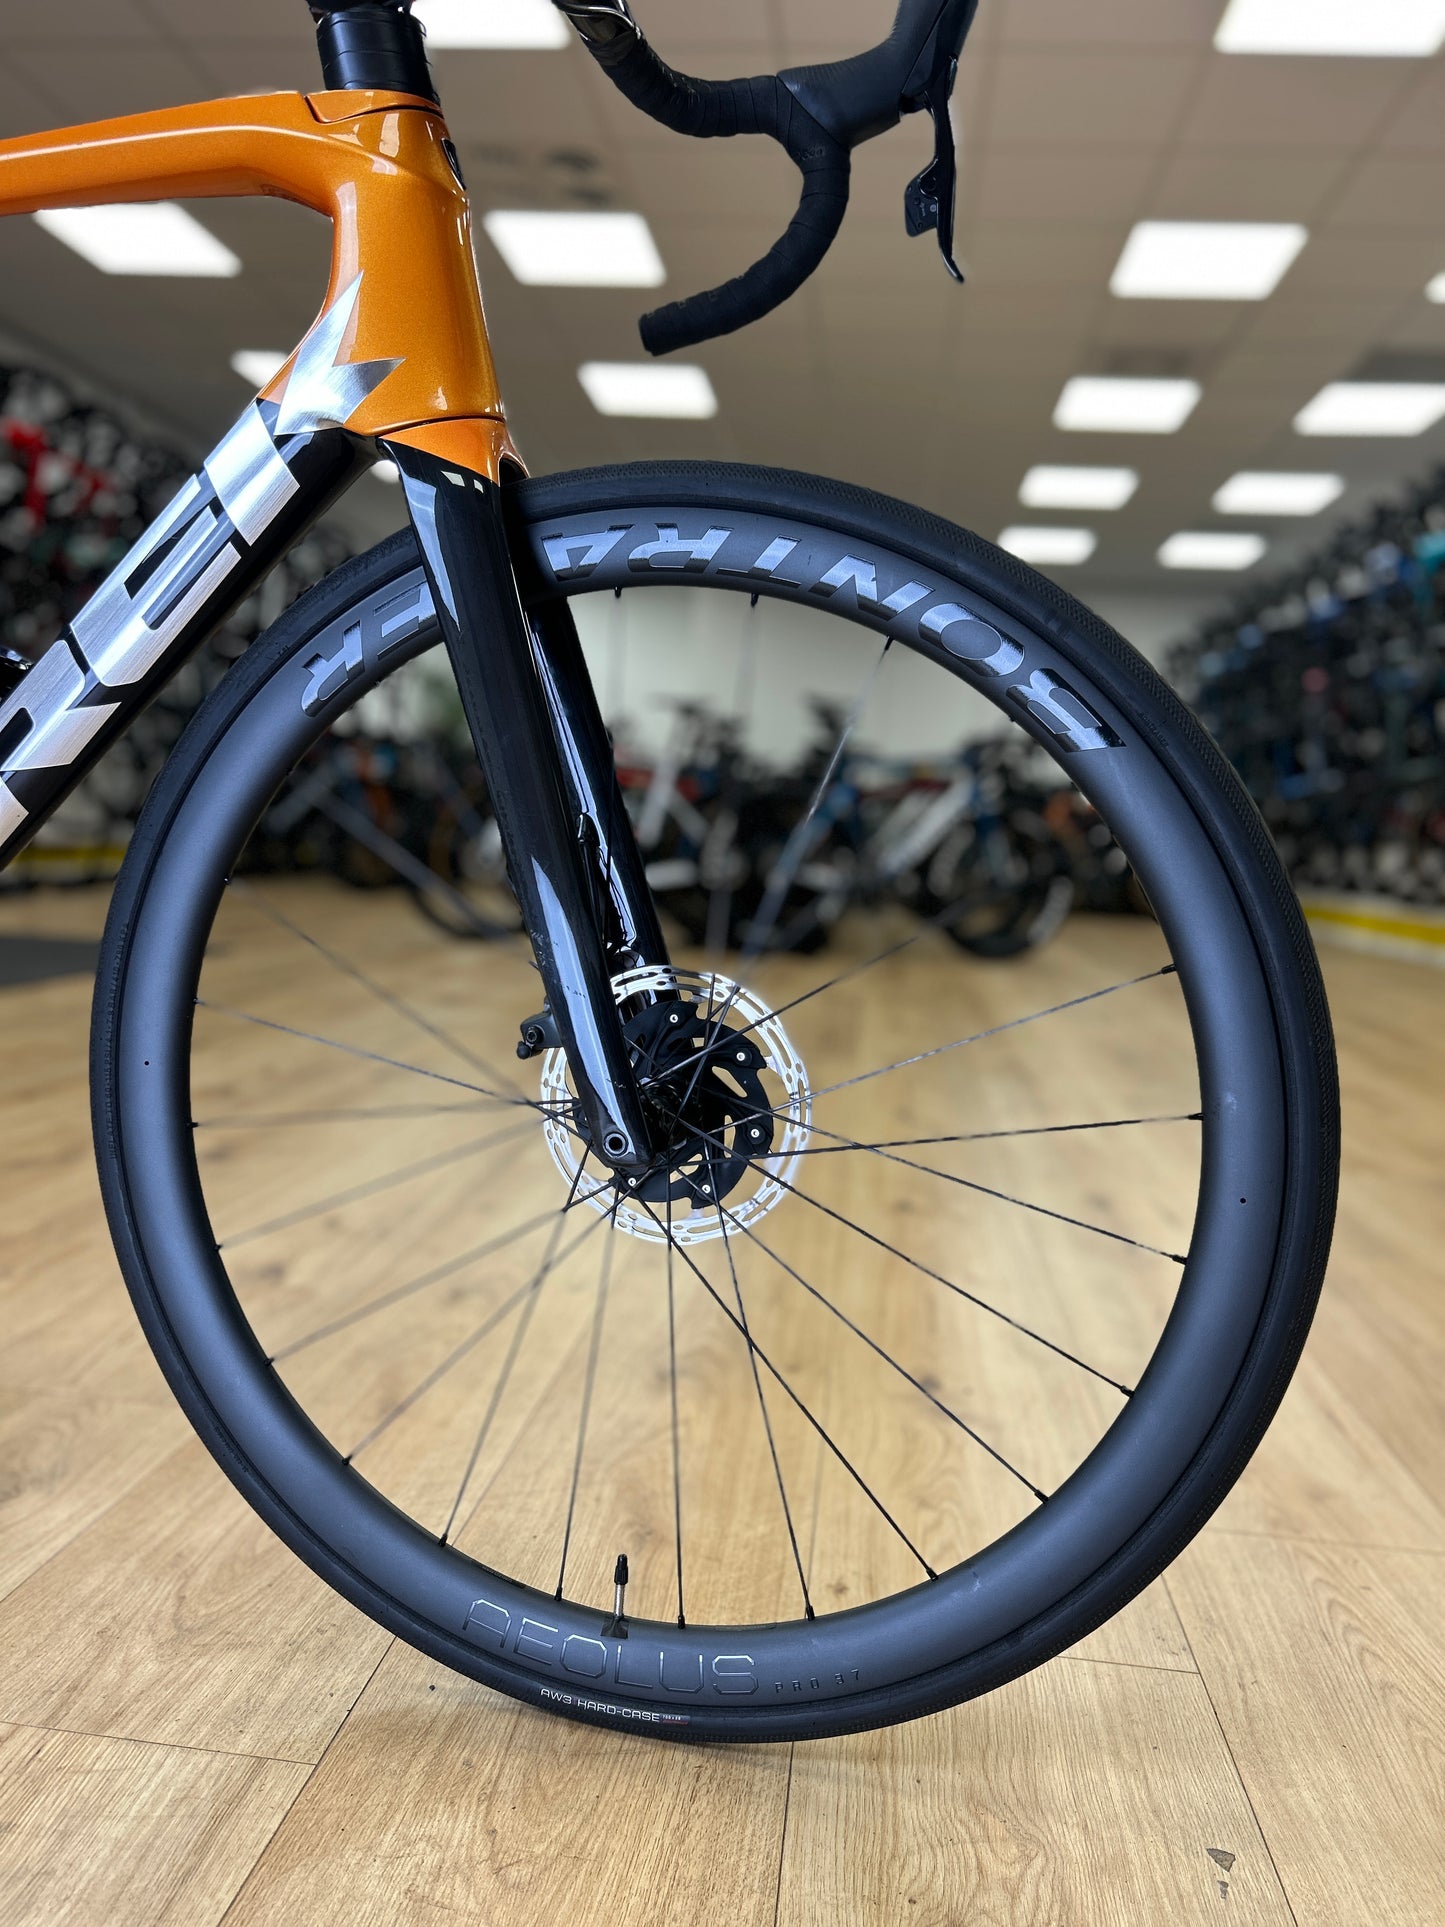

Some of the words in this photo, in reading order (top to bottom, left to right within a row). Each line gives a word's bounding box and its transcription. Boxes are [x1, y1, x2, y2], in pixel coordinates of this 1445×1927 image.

[302, 522, 1126, 752] BONTRAER
[462, 1599, 759, 1696] AEOLUS
[774, 1677, 821, 1694] PRO
[540, 1688, 572, 1705] AW3
[577, 1698, 660, 1723] HARD-CASE
